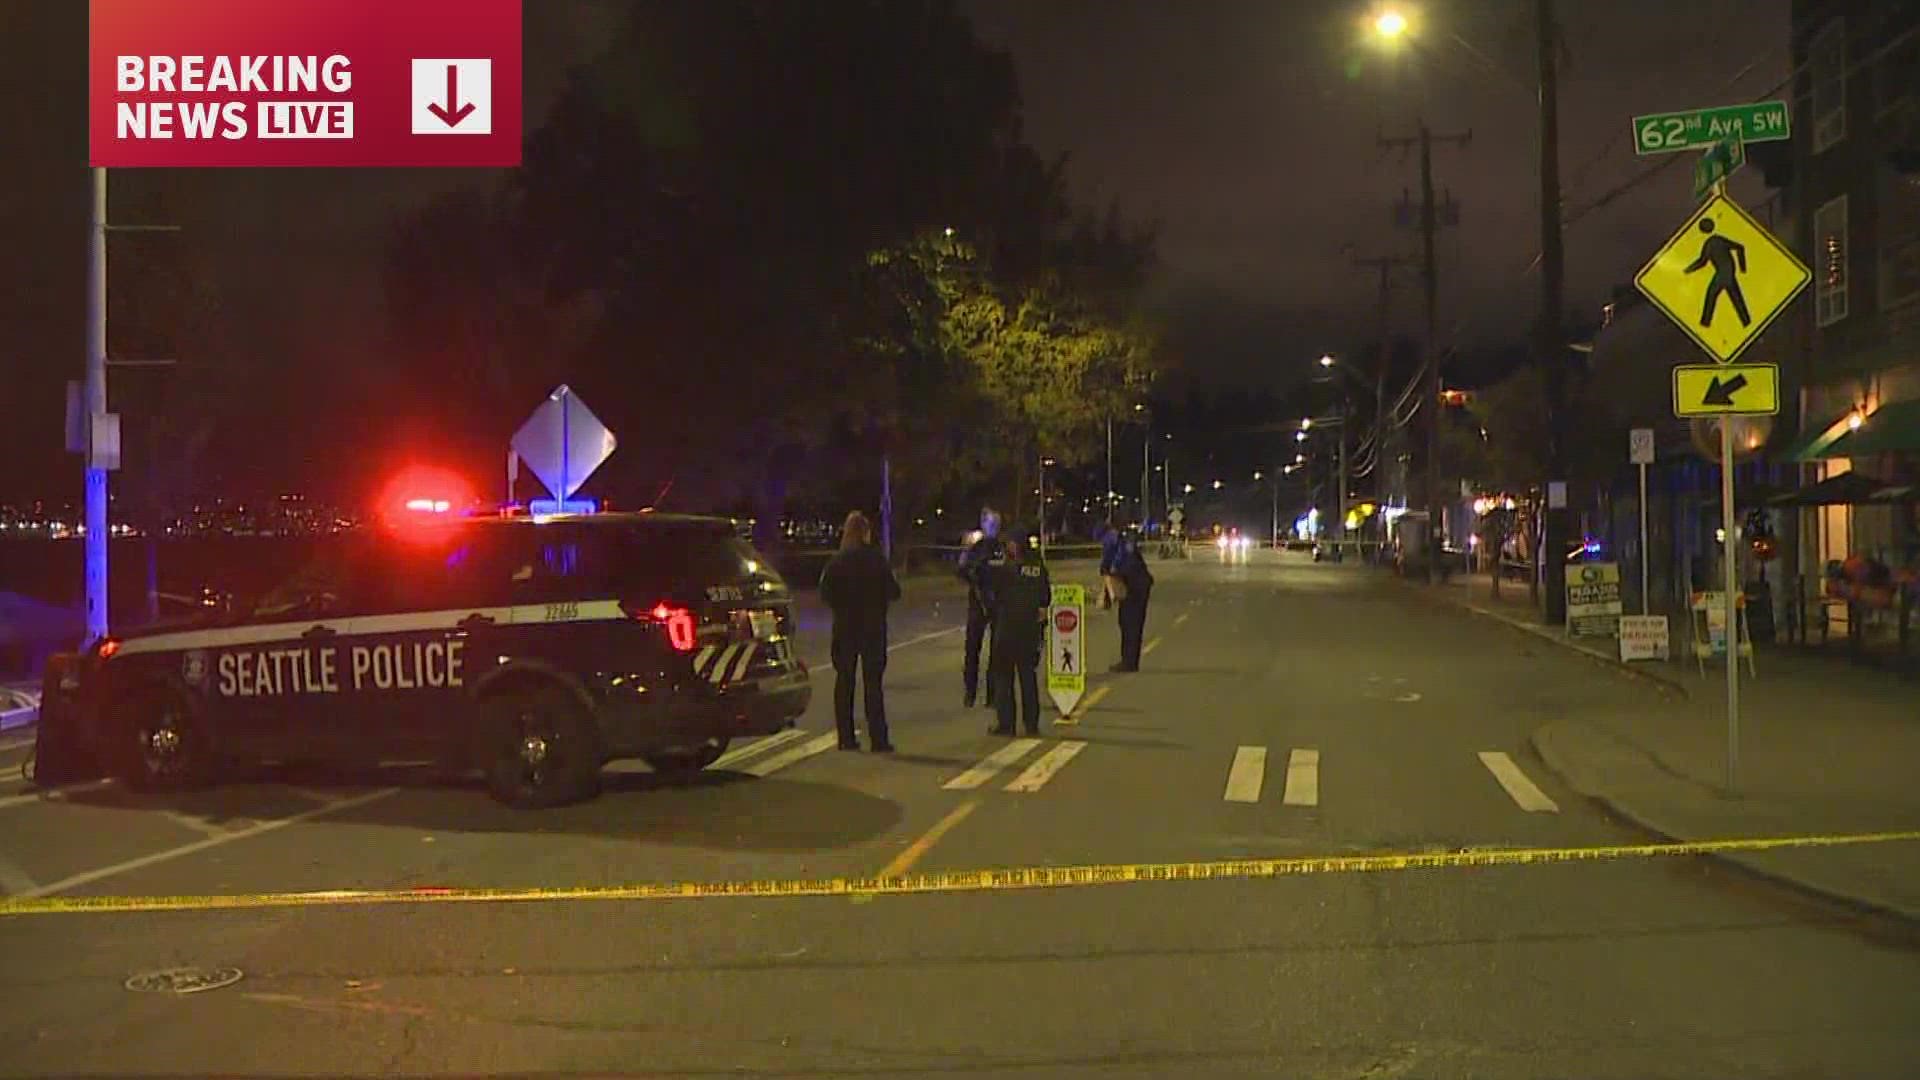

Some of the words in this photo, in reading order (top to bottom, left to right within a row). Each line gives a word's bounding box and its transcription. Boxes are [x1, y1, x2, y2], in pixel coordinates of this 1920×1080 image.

[1641, 113, 1701, 148] 62nd
[1708, 117, 1742, 137] Ave
[1752, 110, 1783, 132] SW
[219, 647, 339, 696] SEATTLE
[352, 641, 465, 690] POLICE
